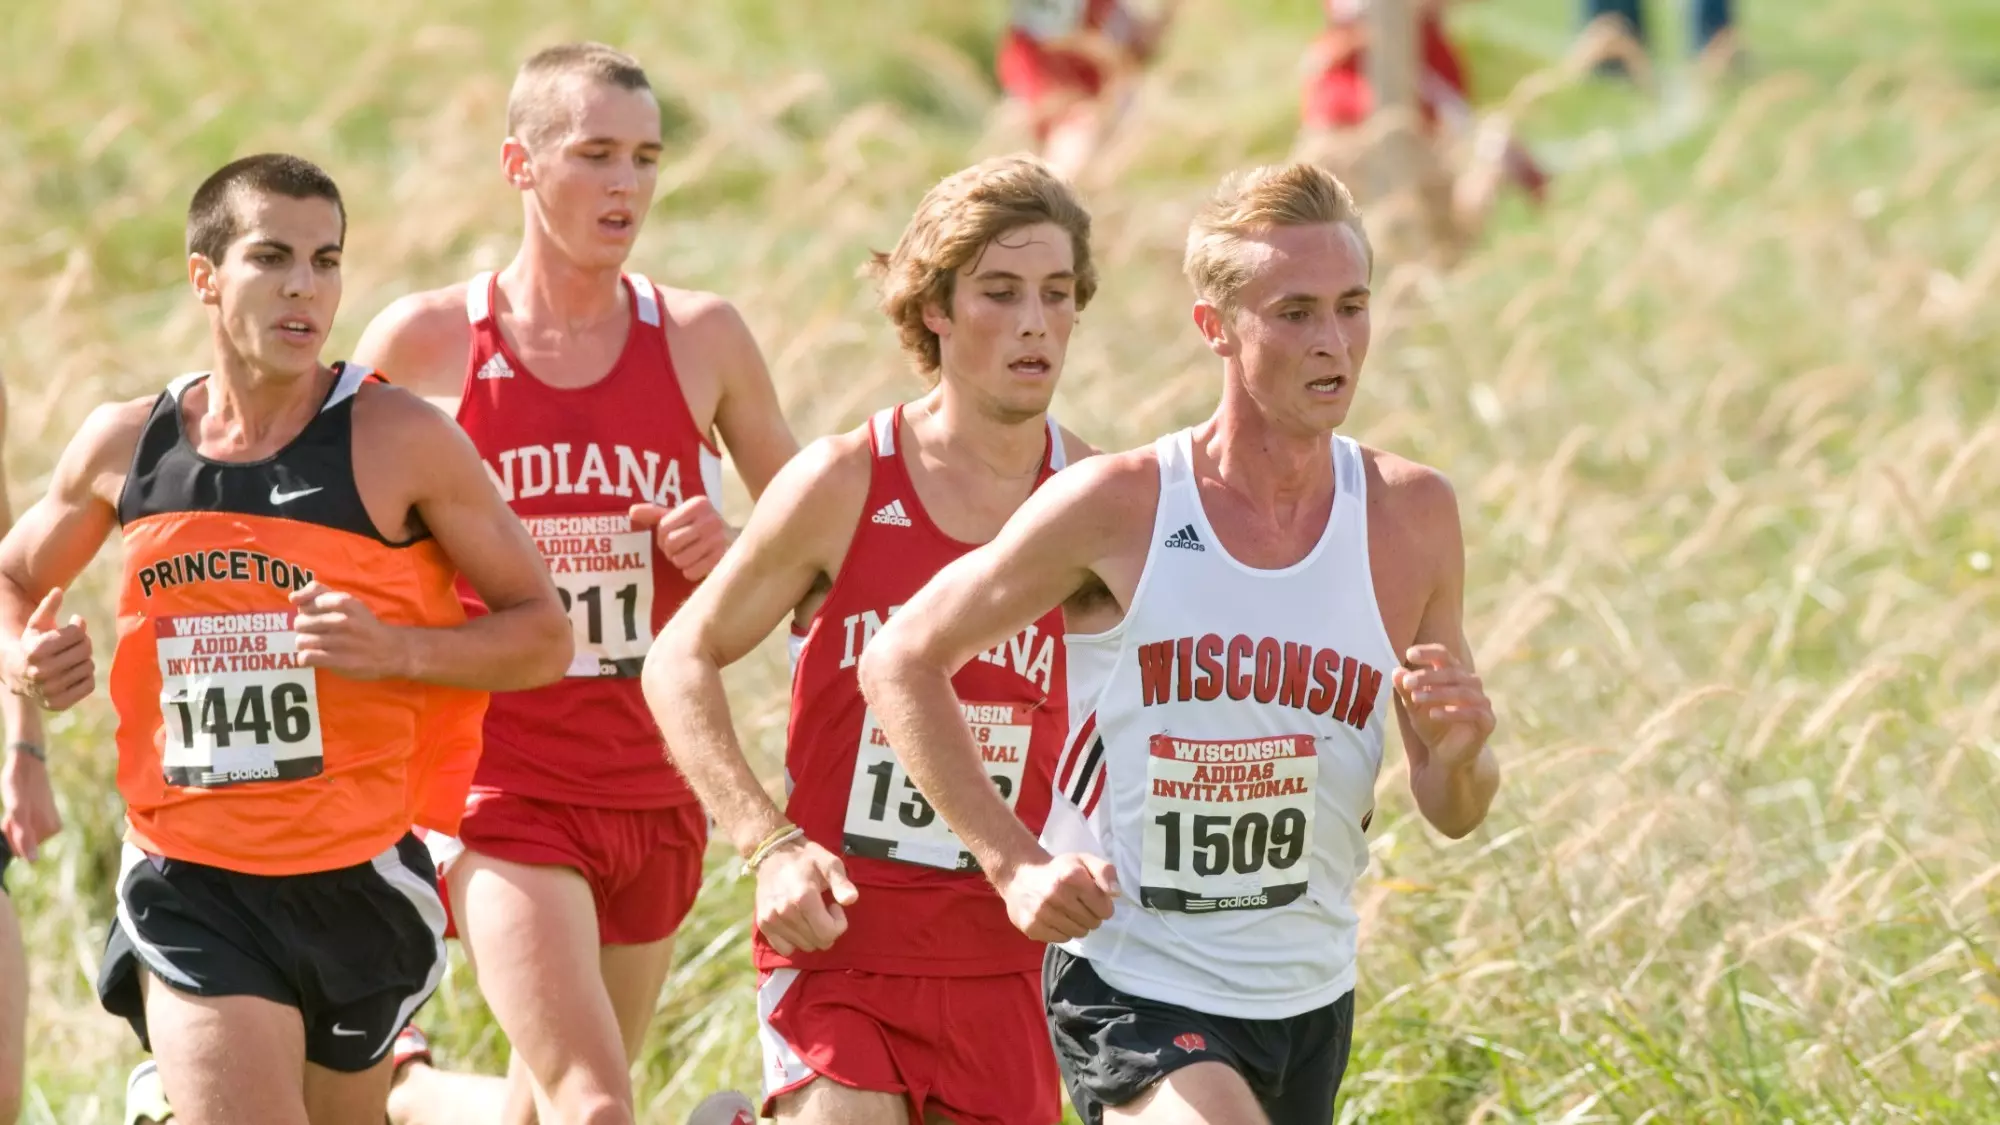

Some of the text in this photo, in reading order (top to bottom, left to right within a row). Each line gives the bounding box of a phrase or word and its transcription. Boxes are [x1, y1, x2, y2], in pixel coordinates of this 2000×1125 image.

[872, 514, 912, 527] adidas
[1164, 538, 1206, 552] adidas
[138, 549, 314, 598] PRINCETON
[172, 612, 289, 637] WISCONSIN
[191, 635, 268, 656] ADIDAS
[1138, 633, 1383, 730] WISCONSIN
[170, 682, 311, 748] 1446
[1172, 738, 1296, 762] WISCONSIN
[230, 767, 279, 781] adidas
[1192, 761, 1274, 784] ADIDAS
[1152, 777, 1308, 803] INVITATIONAL
[1155, 807, 1307, 877] 1509
[1218, 894, 1268, 908] adidas
